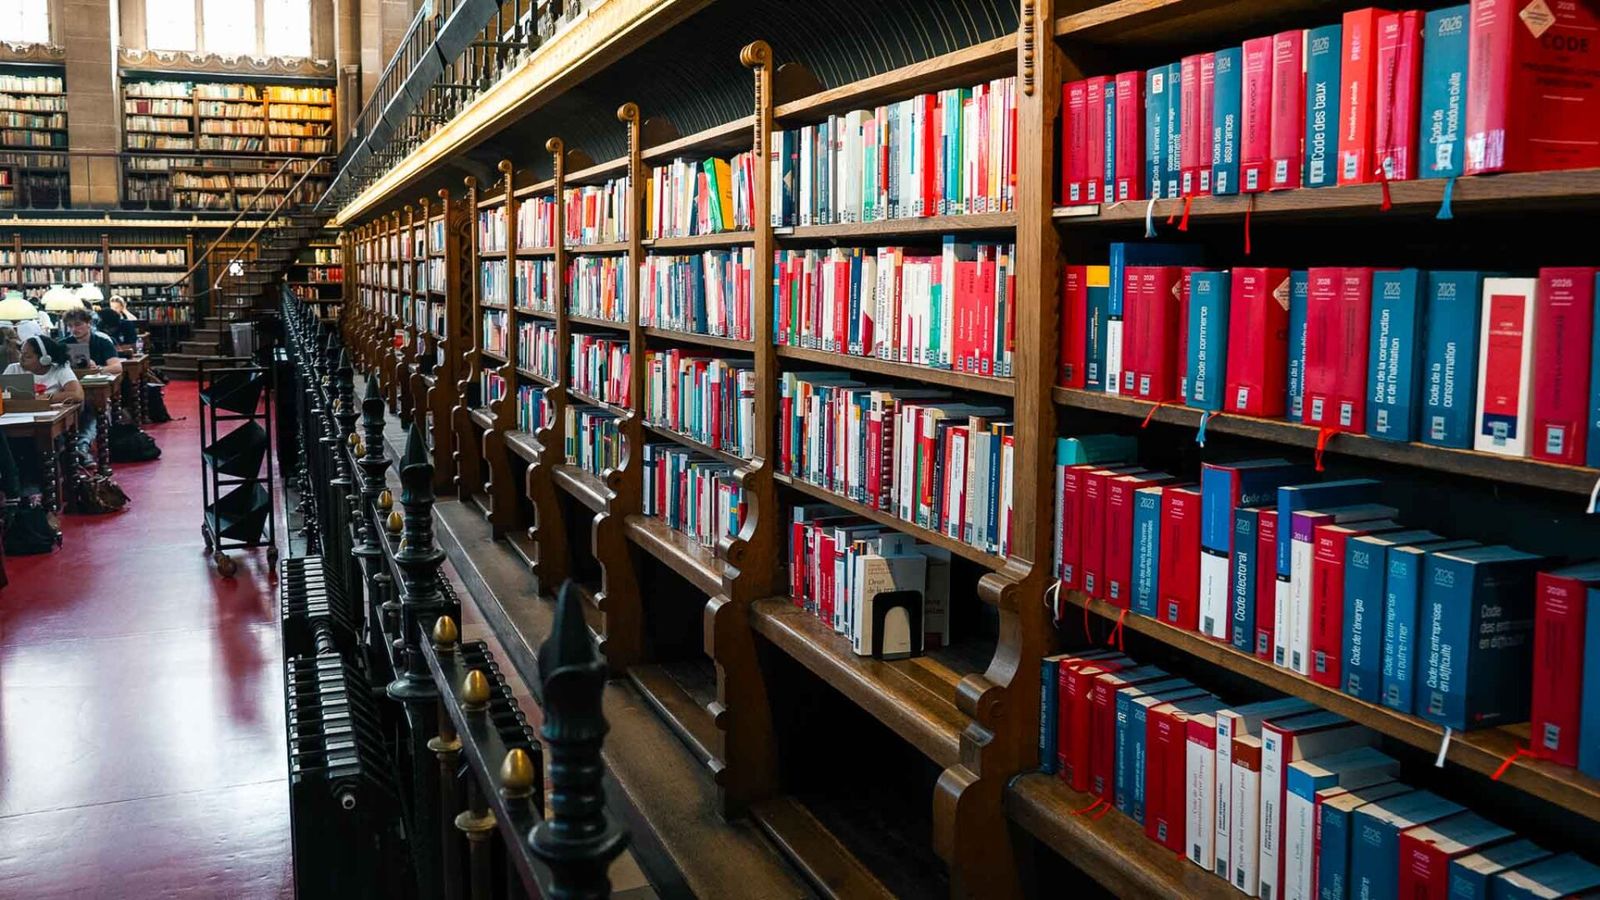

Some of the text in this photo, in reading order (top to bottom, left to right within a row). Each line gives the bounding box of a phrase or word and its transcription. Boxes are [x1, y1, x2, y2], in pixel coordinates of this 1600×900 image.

[1438, 16, 1462, 33] 2026
[1224, 114, 1233, 163] assurances
[1312, 82, 1326, 162] Code des baux
[1430, 110, 1444, 144] Code de
[1444, 96, 1460, 142] procédure
[1213, 144, 1221, 164] Code
[1197, 306, 1208, 380] Code de commerce
[1290, 368, 1298, 377] de
[1375, 309, 1390, 402] Code de la construction
[1387, 338, 1400, 404] et de l'habitation
[1289, 378, 1298, 396] Code
[1429, 363, 1441, 406] Code de la
[1442, 342, 1456, 407] consommation
[1235, 552, 1248, 621] Code électoral
[1351, 598, 1364, 666] Code de l'énergie
[1384, 593, 1397, 676] Code de l'entreprise
[1397, 622, 1408, 681] en outre-mer
[1427, 602, 1443, 688] Code des entreprises
[1440, 644, 1452, 692] en difficulté
